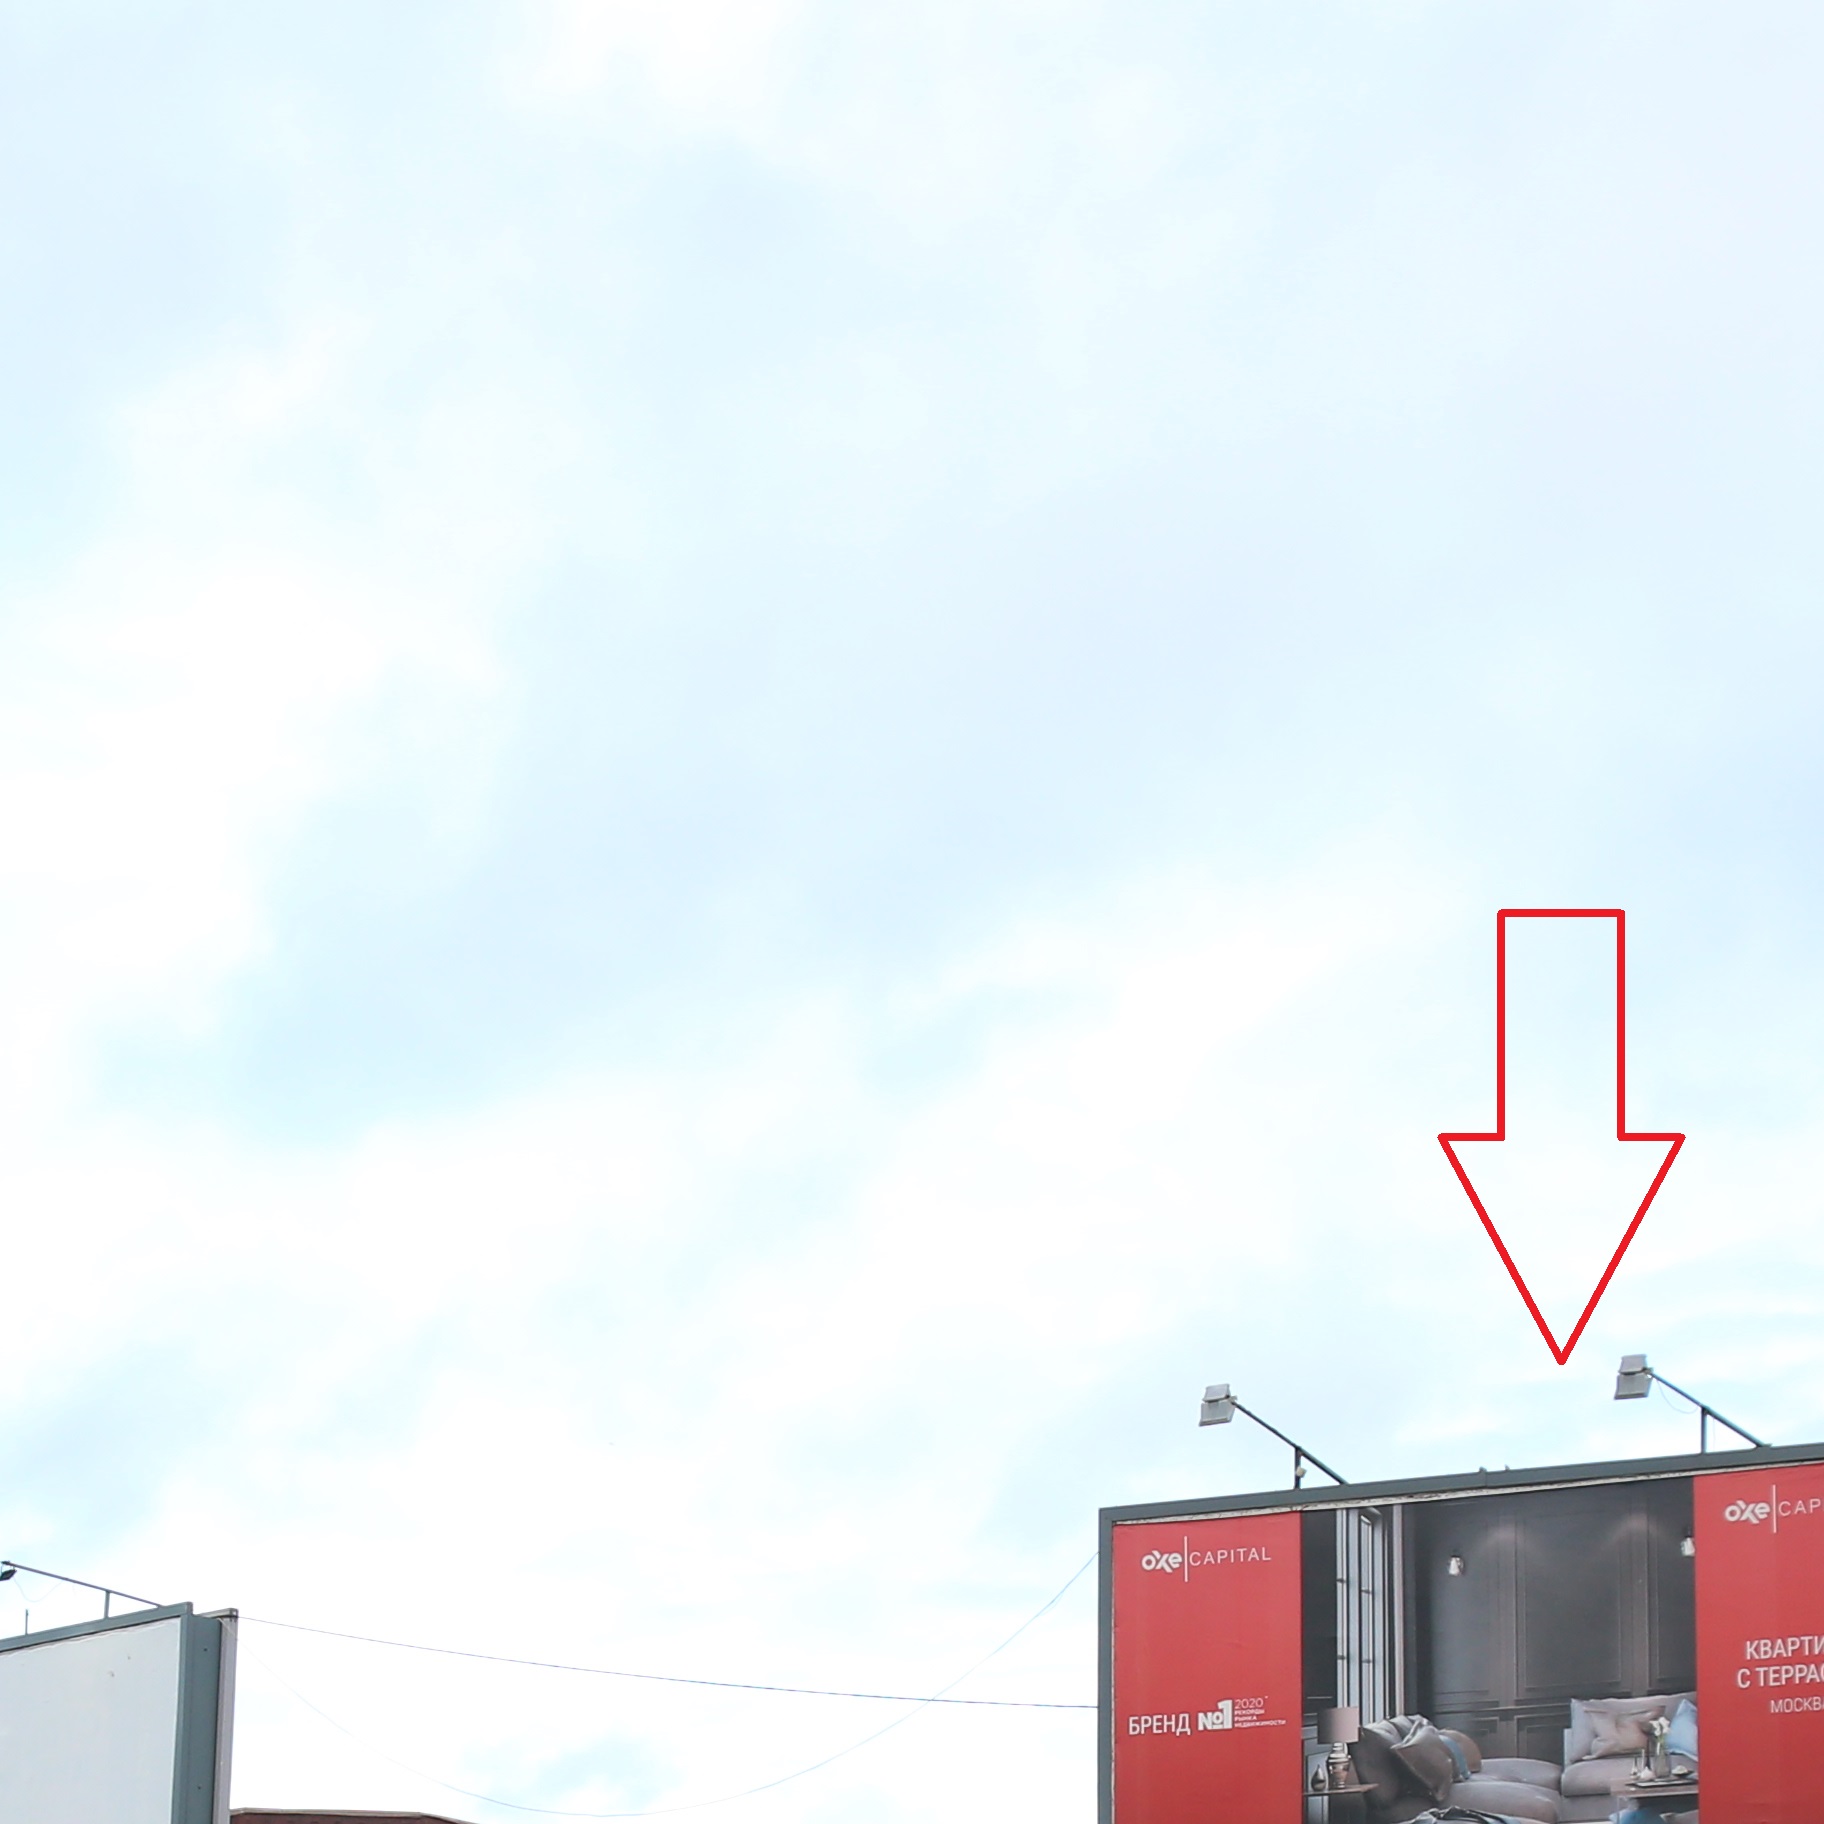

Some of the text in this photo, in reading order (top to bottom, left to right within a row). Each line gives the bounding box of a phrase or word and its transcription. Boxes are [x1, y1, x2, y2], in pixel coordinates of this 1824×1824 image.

[1189, 1547, 1271, 1566] CAPITAL
[1737, 1668, 1751, 1688] С
[1129, 1713, 1191, 1736] БРЕНД
